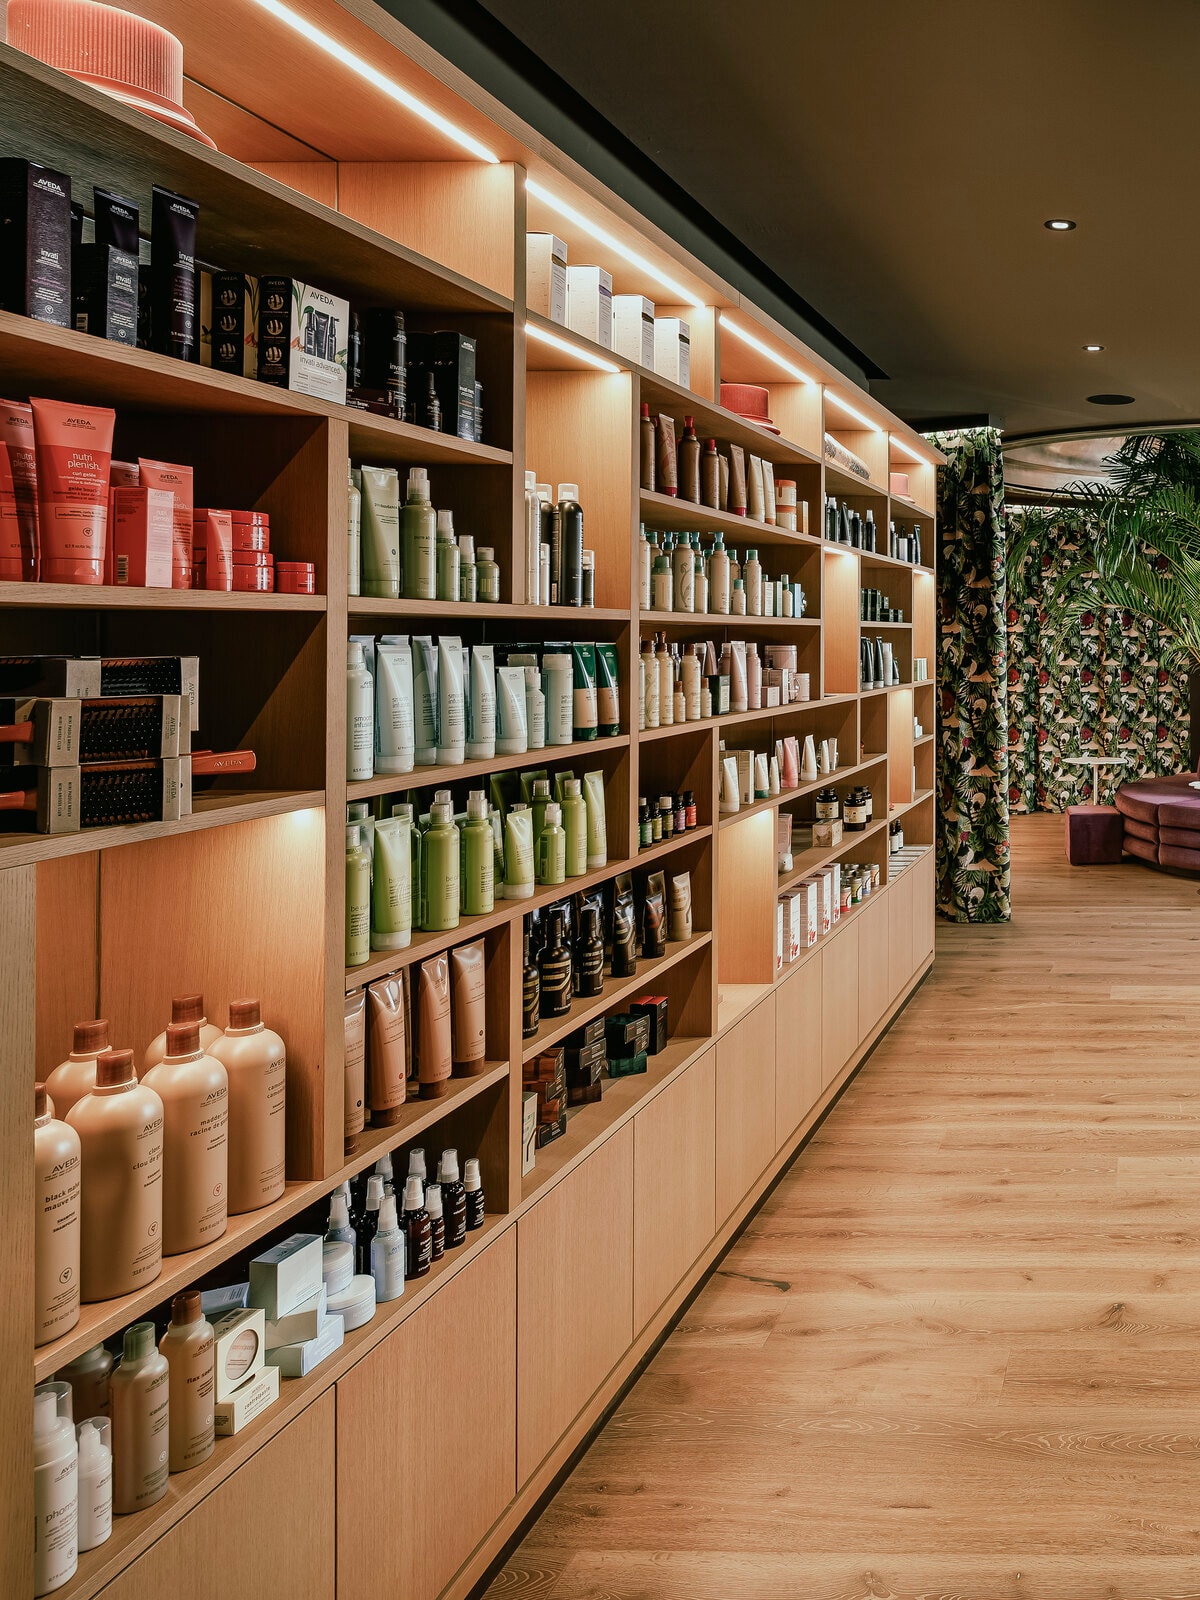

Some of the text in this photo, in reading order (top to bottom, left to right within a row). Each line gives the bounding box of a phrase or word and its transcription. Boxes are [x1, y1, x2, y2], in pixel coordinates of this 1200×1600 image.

[38, 178, 62, 192] AVEDA
[112, 205, 129, 215] AVEDA
[172, 203, 191, 214] AVEDA
[41, 249, 59, 260] invati
[115, 273, 132, 285] invati
[309, 291, 335, 307] AVEDA
[300, 354, 316, 367] invati
[9, 416, 29, 425] AVEDA
[67, 418, 92, 426] AVEDA
[72, 452, 93, 462] nutri
[160, 473, 179, 481] AVEDA
[214, 760, 242, 768] AVEDA
[200, 1113, 222, 1126] madder
[190, 1126, 212, 1137] racine
[51, 1156, 79, 1174] AVEDA
[132, 1160, 148, 1170] clou
[45, 1191, 66, 1204] black
[44, 1199, 69, 1213] mauve
[187, 1376, 200, 1384] flax
